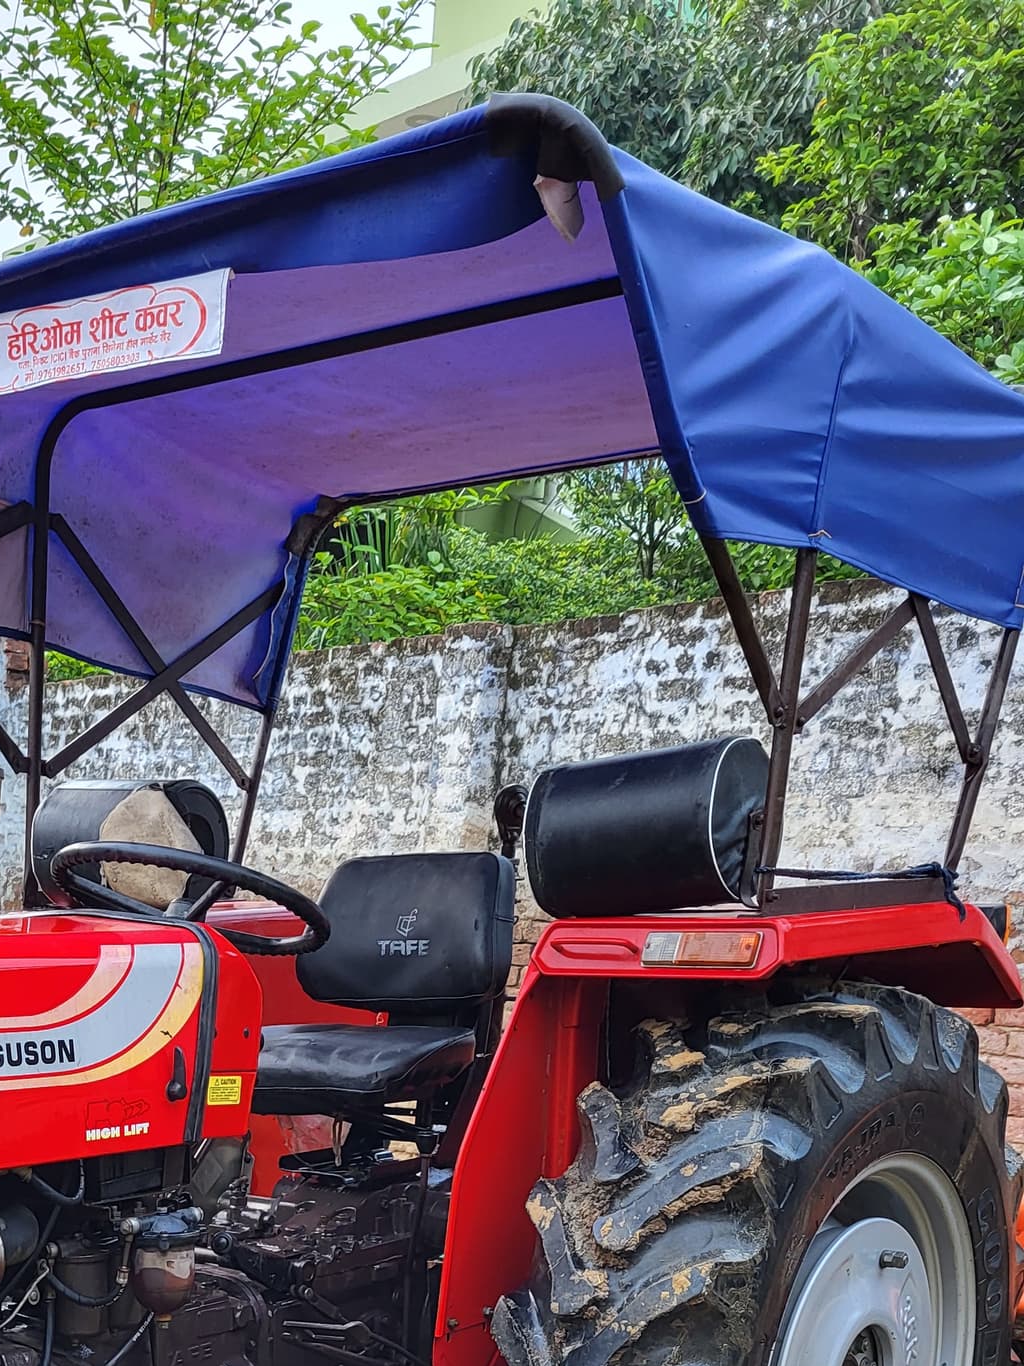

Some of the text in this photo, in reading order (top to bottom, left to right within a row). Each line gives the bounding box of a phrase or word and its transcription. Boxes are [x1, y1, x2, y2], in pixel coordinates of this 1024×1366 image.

[7, 299, 186, 361] हरिओम शीट कवर
[377, 939, 430, 956] TAFE
[86, 1121, 150, 1141] HIGH LIFT
